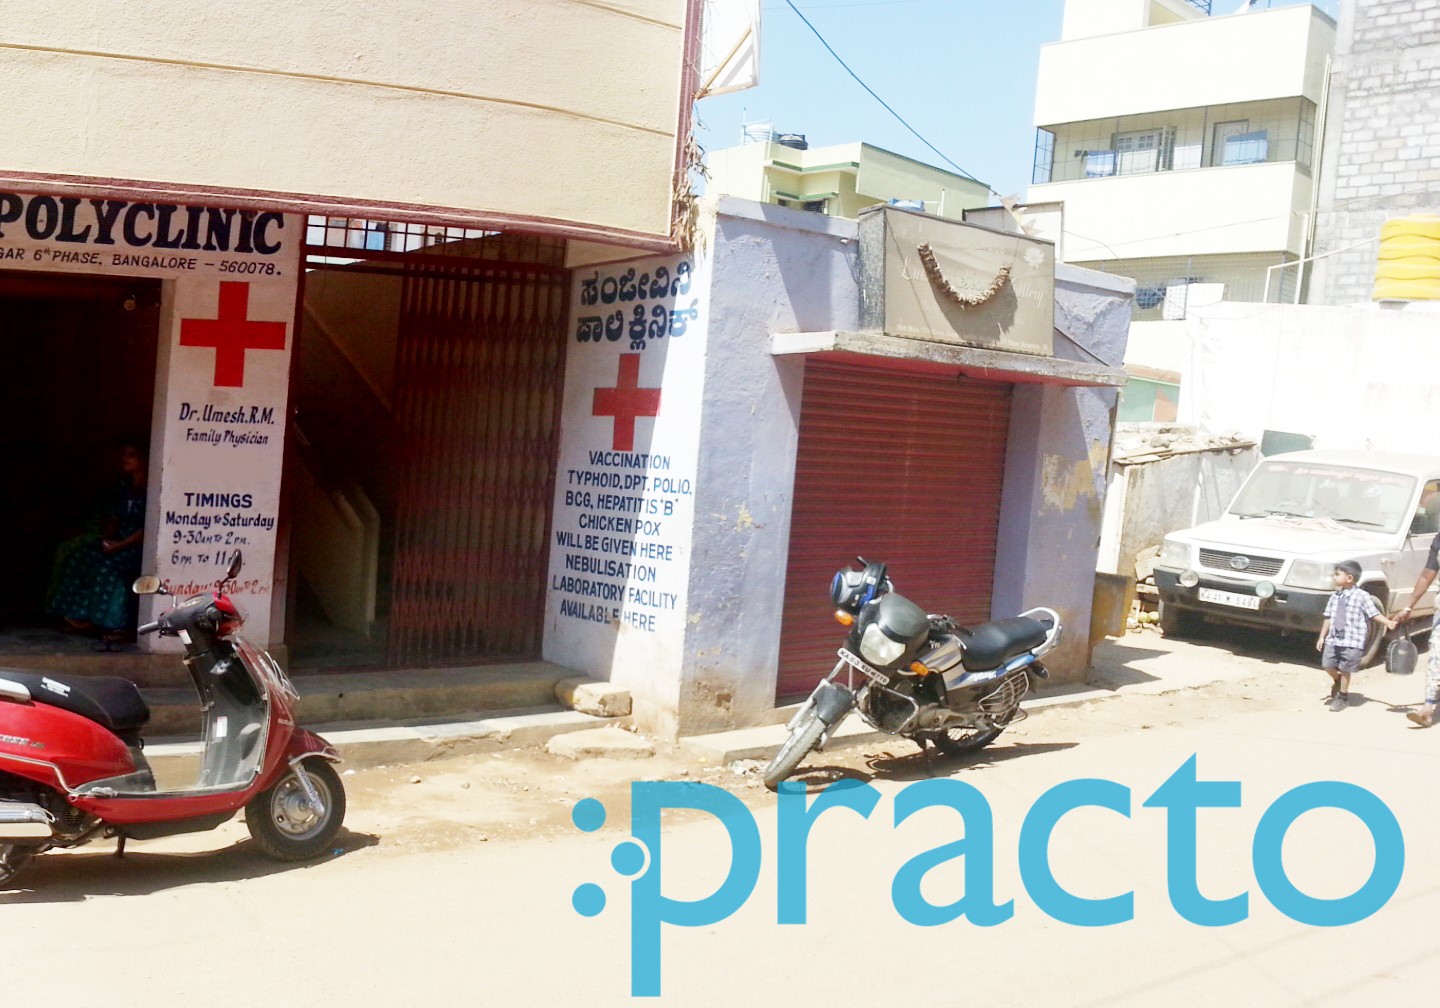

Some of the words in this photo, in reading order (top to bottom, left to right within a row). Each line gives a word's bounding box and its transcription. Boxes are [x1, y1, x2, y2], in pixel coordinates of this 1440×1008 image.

[111, 254, 198, 271] BANGALORE
[186, 428, 222, 446] Family
[223, 430, 269, 448] Physician
[589, 451, 671, 470] VACCINATION
[184, 492, 253, 508] TIMINGS
[597, 494, 658, 514] HEPATITIS
[166, 511, 212, 529] Monday
[222, 512, 275, 530] Saturday
[579, 514, 633, 533] CHICKEN
[635, 519, 662, 536] POX
[556, 531, 583, 548] WILL
[584, 535, 600, 551] BE
[601, 536, 637, 557] GIVEN
[640, 543, 673, 561] HERE
[565, 554, 656, 583] NEBULISATION
[552, 575, 625, 602] LABORATORY
[629, 587, 678, 610] FACILITY
[623, 610, 656, 632] HERE
